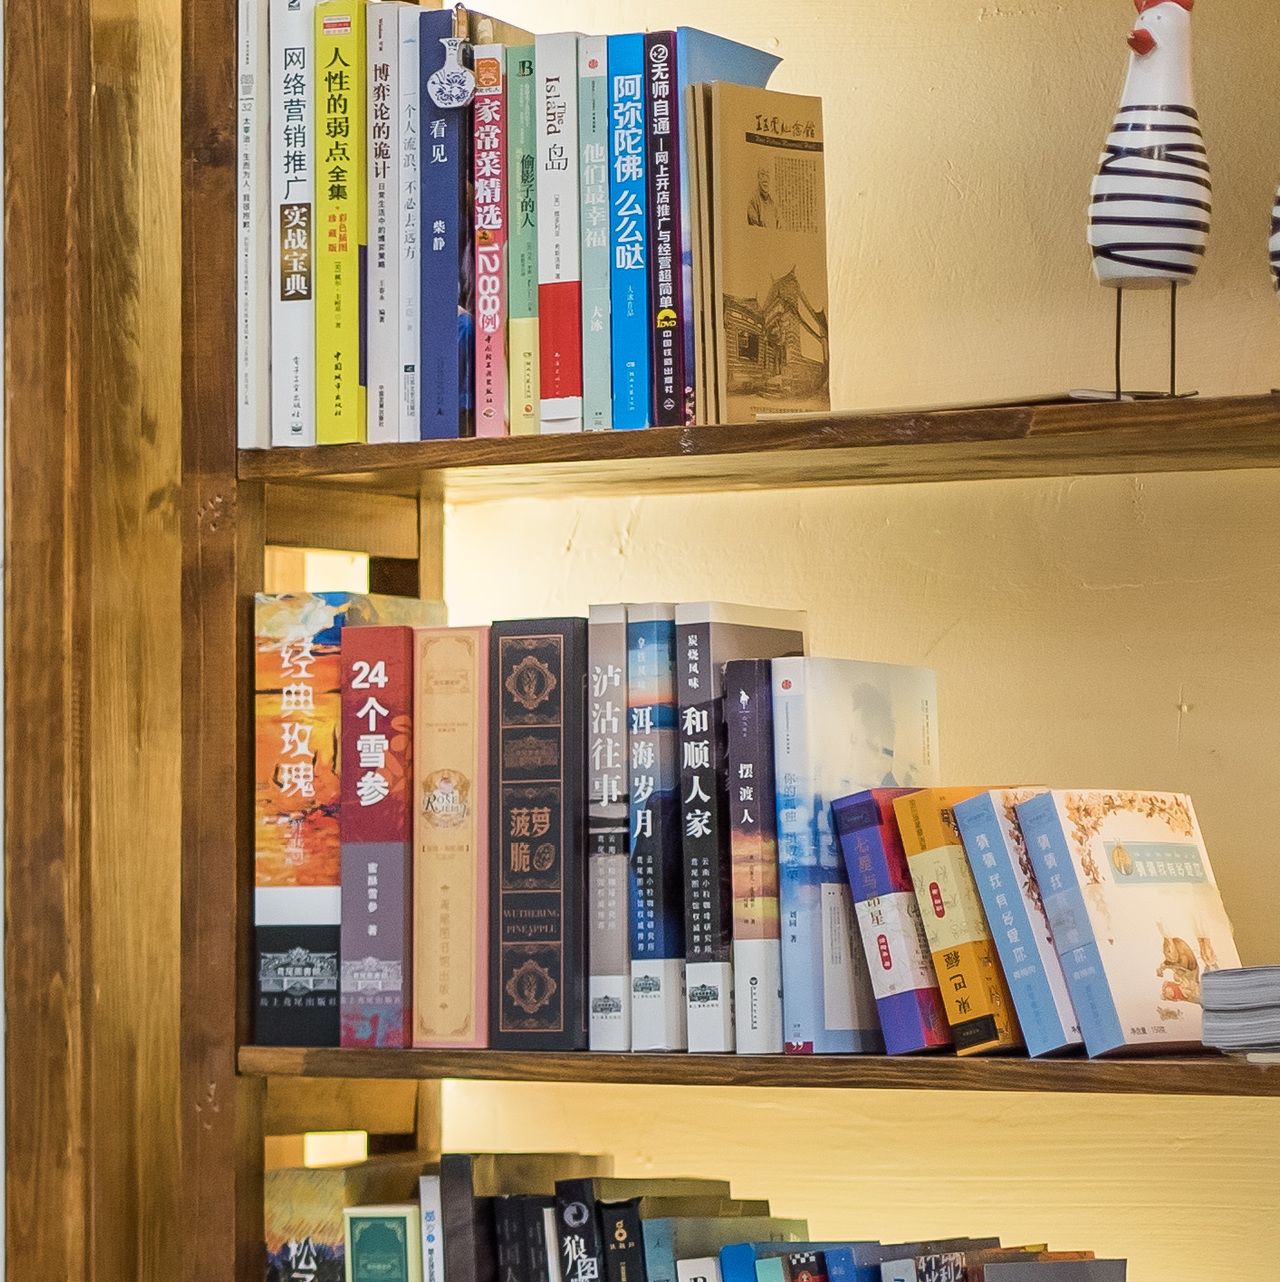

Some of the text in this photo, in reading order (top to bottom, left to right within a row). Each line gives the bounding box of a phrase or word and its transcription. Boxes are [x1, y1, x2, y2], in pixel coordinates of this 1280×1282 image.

[283, 47, 307, 200] 网络营销推广
[324, 47, 351, 162] 人性的弱点
[372, 63, 391, 179] 博弈论的诡计
[429, 118, 448, 164] 看见
[545, 76, 561, 136] Island
[556, 102, 567, 125] The
[327, 165, 349, 201] 全集
[474, 99, 502, 231] 家常菜精选
[521, 154, 535, 228] 偷影子的人
[545, 144, 568, 171] 岛
[584, 143, 606, 248] 他们最幸福
[613, 74, 644, 270] 阿弥陀佛 么么哒
[283, 206, 308, 296] 实战宝典
[432, 219, 446, 251] 柴静
[687, 634, 700, 690] 炭烧风味
[280, 635, 316, 798] 经典玫瑰
[351, 661, 389, 806] 24个雪参
[592, 664, 622, 808] 泸沽往事
[632, 707, 655, 838] 洱海岁月
[682, 706, 712, 838] 和顺人家
[739, 763, 754, 824] 摆渡人
[510, 807, 551, 838] 菠萝
[510, 842, 530, 873] 脆
